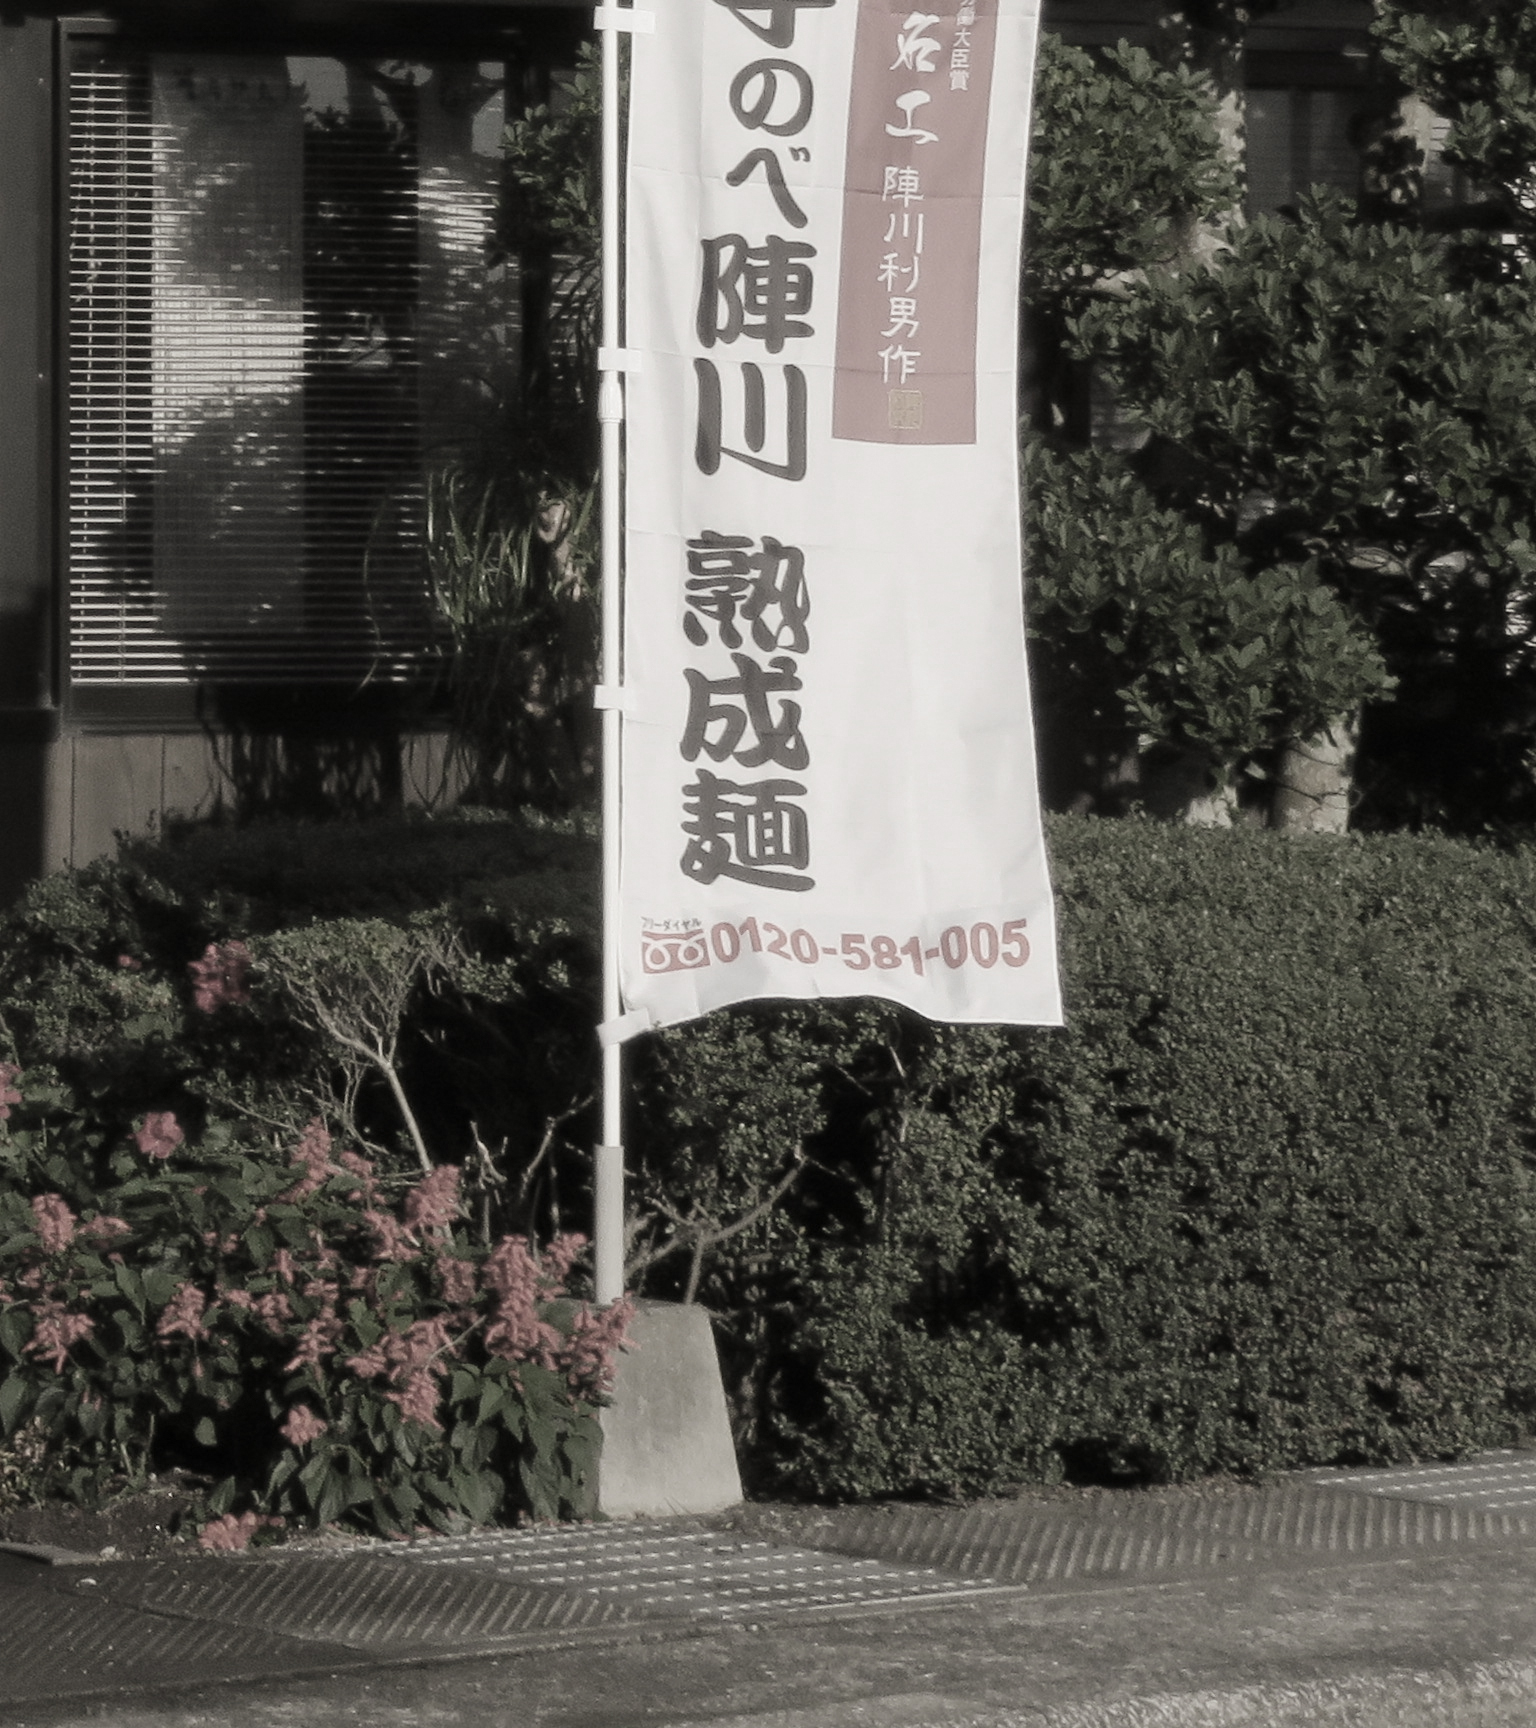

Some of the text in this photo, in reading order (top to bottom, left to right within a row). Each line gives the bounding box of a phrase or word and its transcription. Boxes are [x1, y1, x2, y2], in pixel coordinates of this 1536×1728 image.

[876, 164, 926, 386] 陣川利男作
[679, 528, 817, 893] 熟成麺
[710, 916, 1031, 976] 0120-581-005
